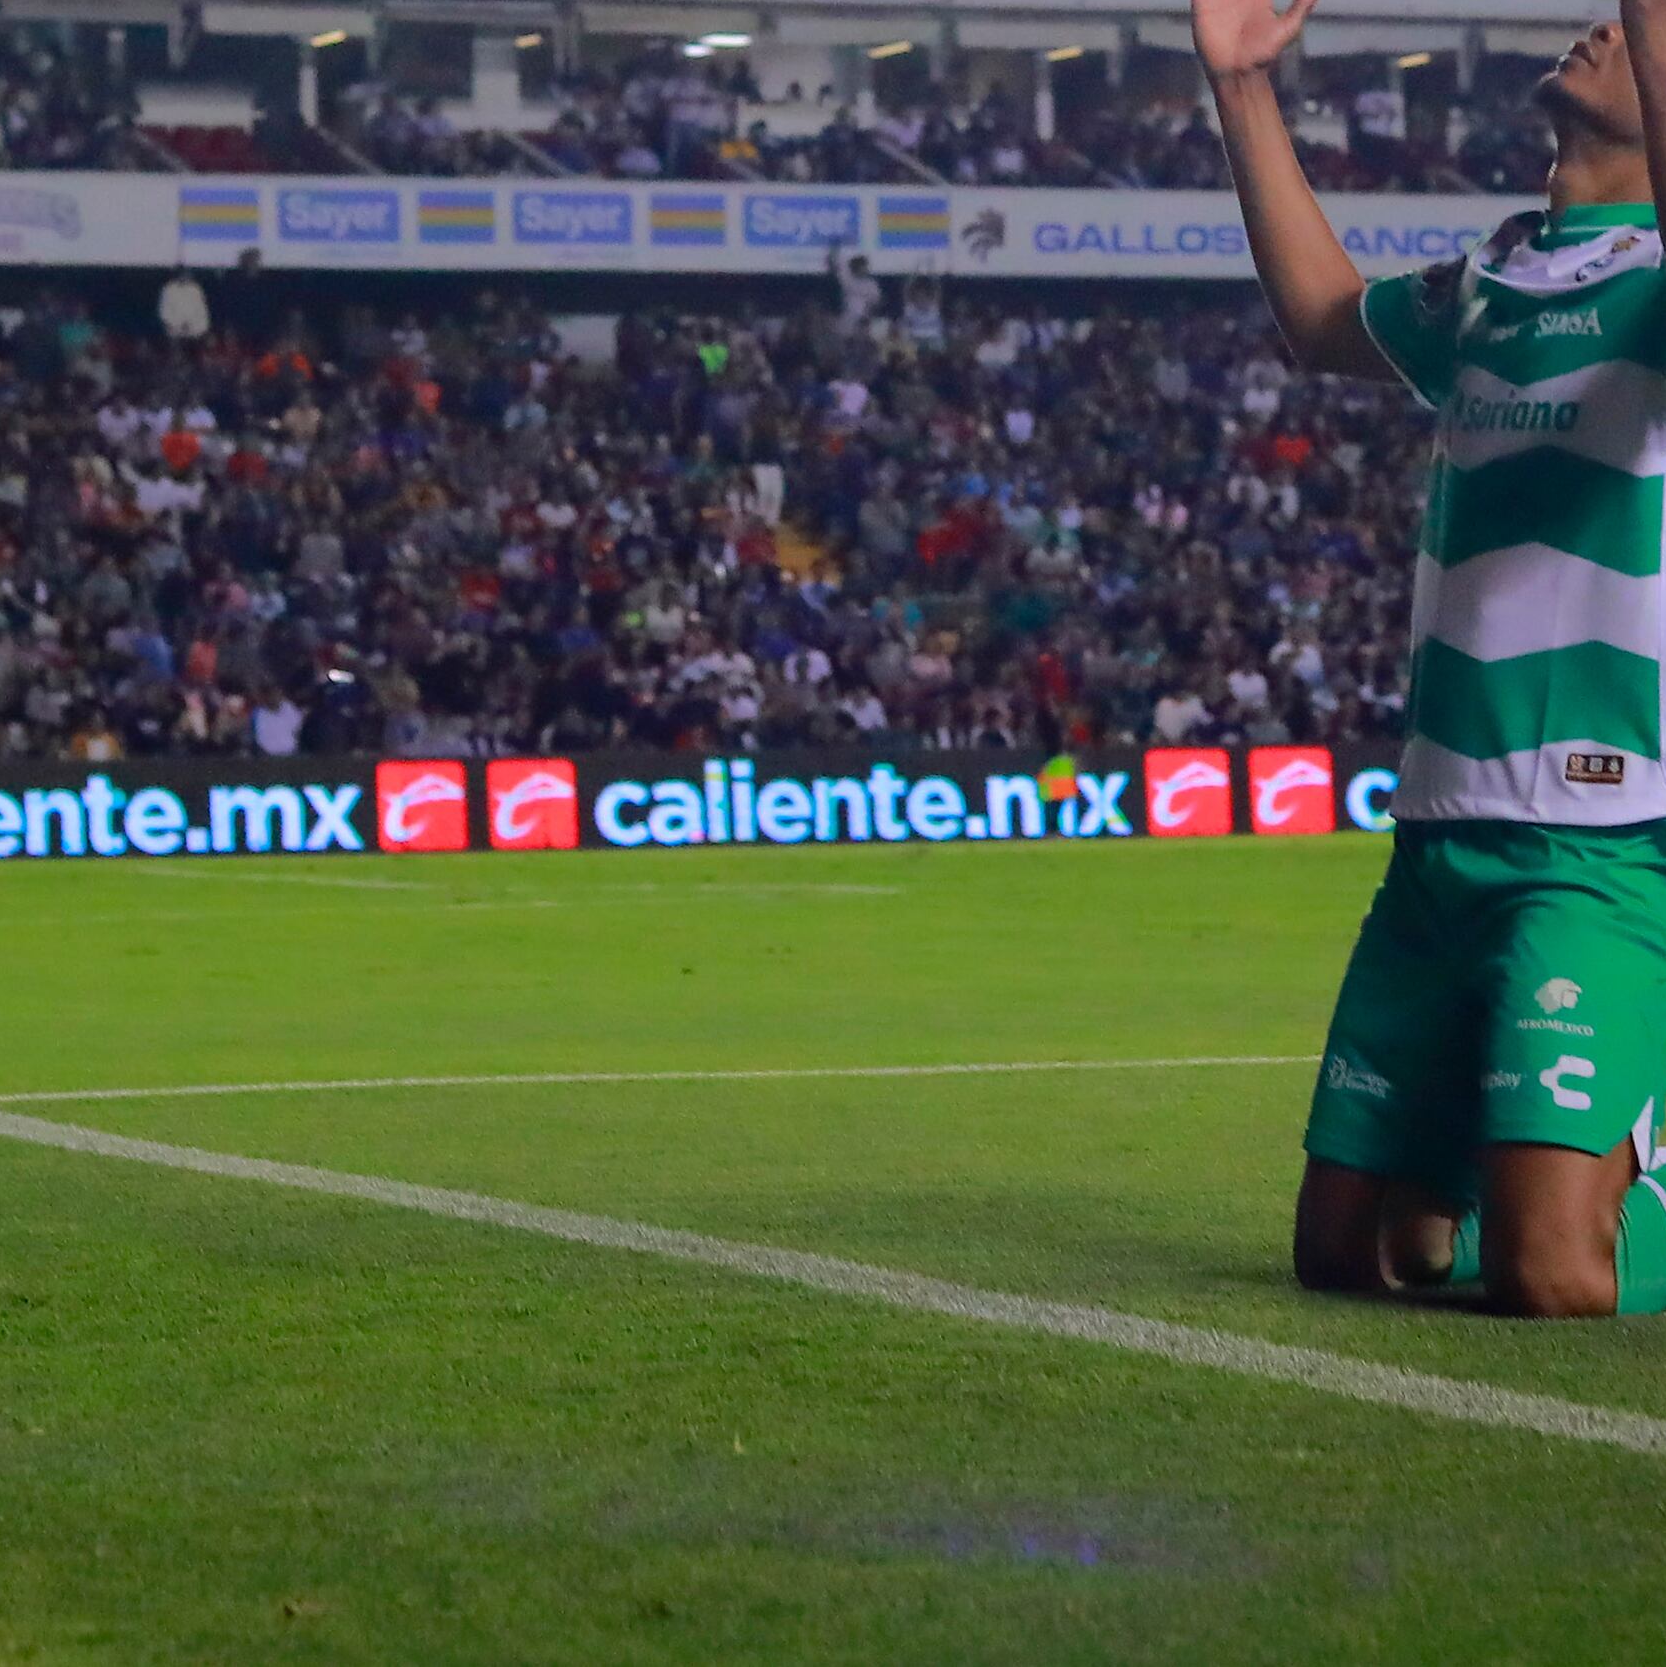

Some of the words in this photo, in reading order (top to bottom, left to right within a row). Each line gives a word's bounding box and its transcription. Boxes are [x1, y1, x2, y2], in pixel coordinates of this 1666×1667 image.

[286, 194, 389, 233] Sayer
[519, 199, 620, 241] Sayer
[750, 201, 847, 243] Sayer
[1033, 222, 1244, 257] GALLOS
[593, 758, 1133, 848] caliente.mx
